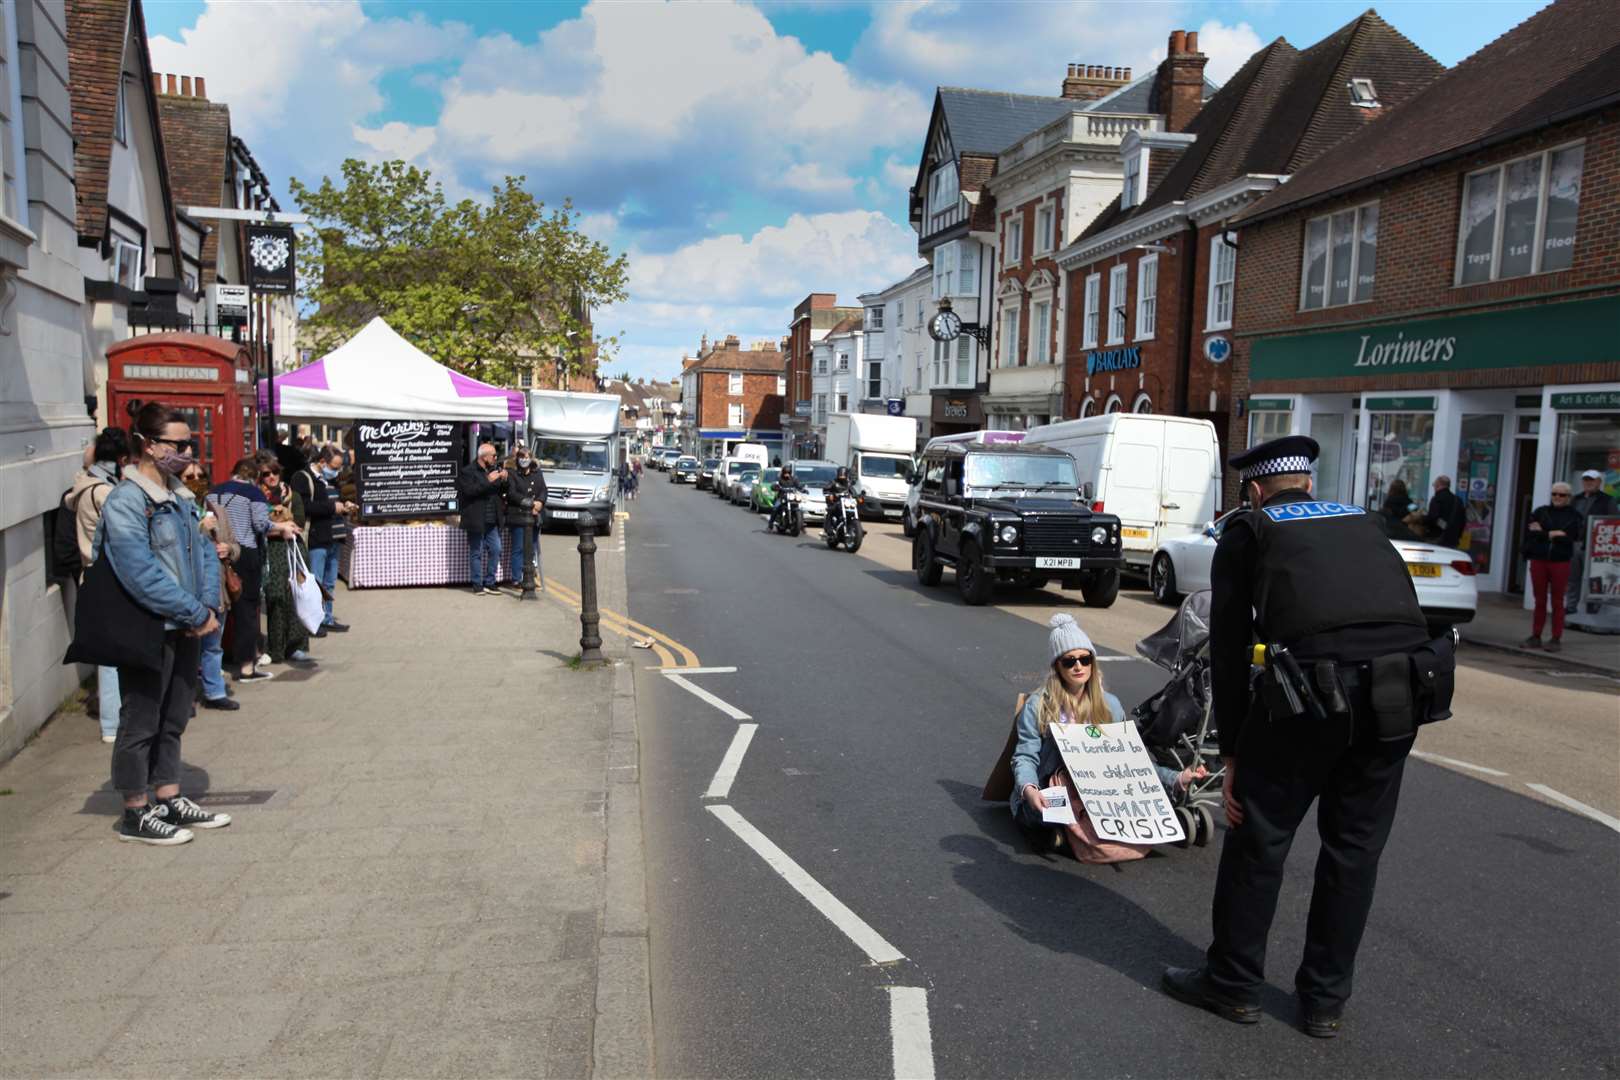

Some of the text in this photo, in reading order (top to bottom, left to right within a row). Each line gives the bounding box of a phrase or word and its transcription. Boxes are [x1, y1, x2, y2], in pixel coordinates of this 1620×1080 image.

[1509, 244, 1528, 257] 1st
[1353, 331, 1457, 367] Lorimers
[1095, 347, 1139, 371] BARCLAYS
[128, 366, 214, 380] TELEPHONE
[1269, 503, 1360, 518] POLICE
[1060, 739, 1079, 753] I'm
[1081, 738, 1126, 754] terrified
[1070, 763, 1152, 779] have children
[1076, 780, 1161, 797] because of the
[1084, 798, 1170, 818] CLIMATE
[1100, 817, 1179, 839] CRISIS
